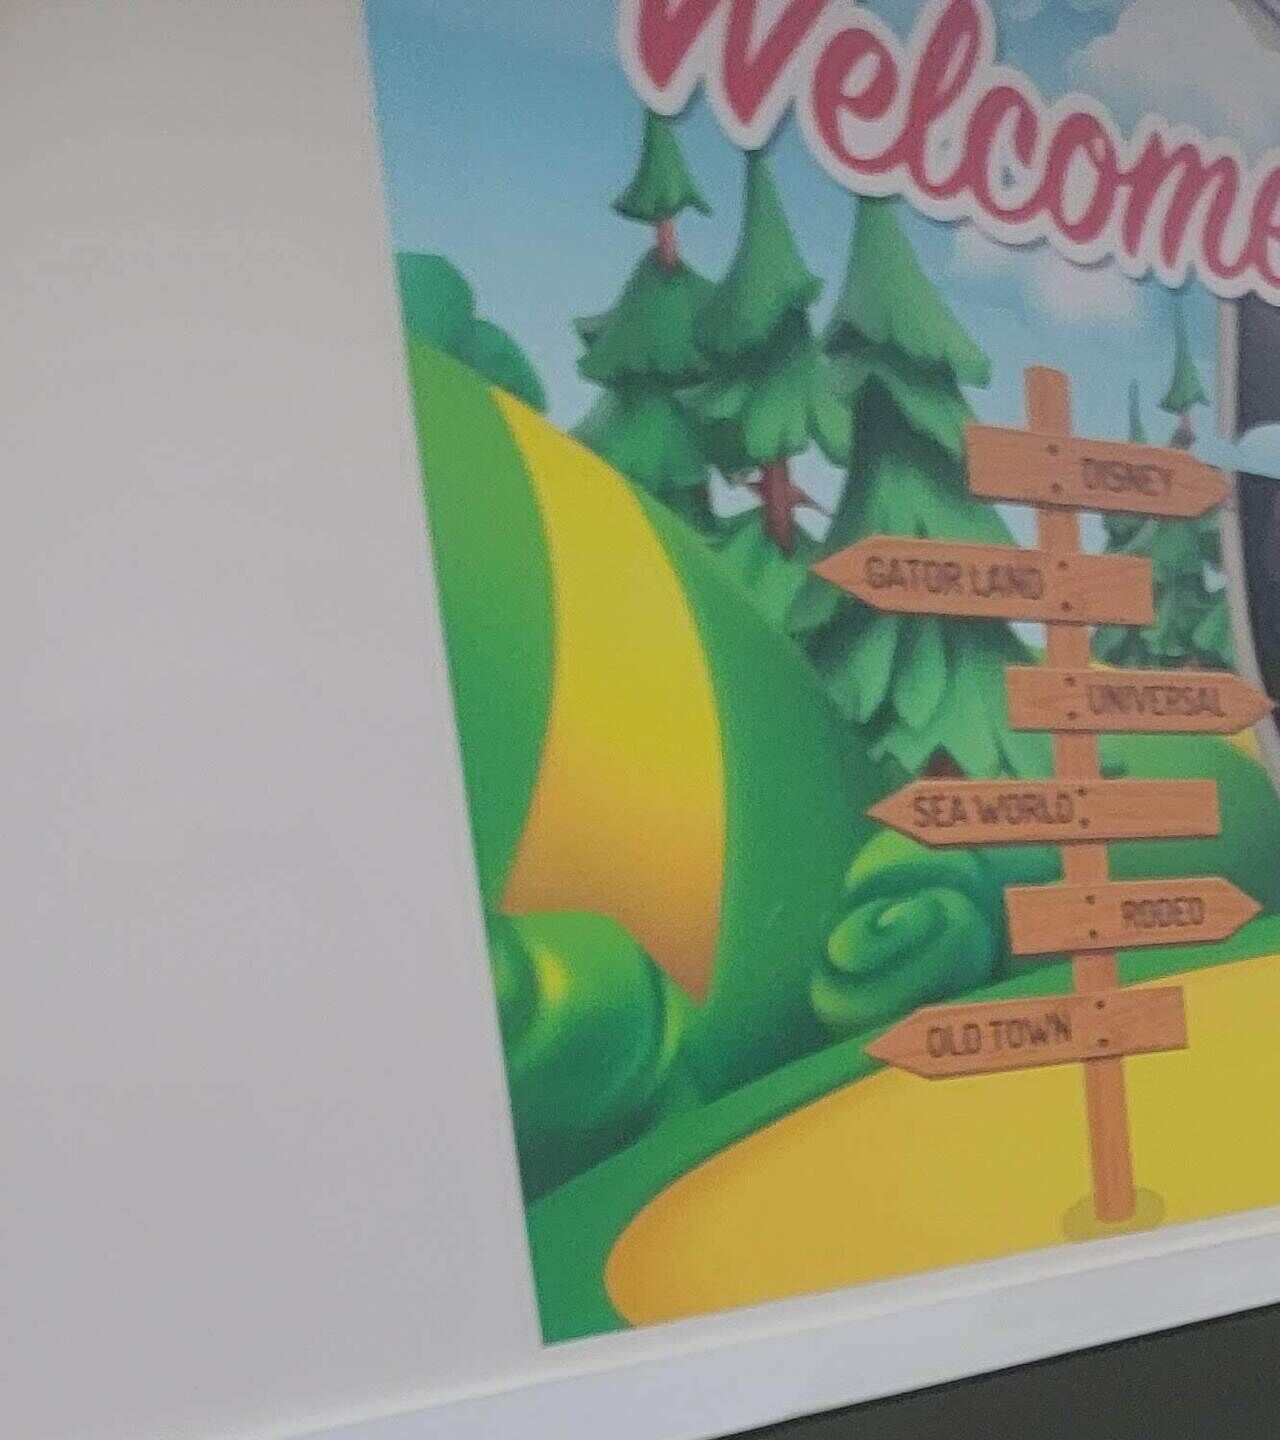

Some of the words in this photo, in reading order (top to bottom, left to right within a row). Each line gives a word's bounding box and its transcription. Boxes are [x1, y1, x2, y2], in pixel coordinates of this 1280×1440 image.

[1081, 457, 1174, 497] DISNEY
[864, 556, 962, 595] GATOR
[970, 567, 1044, 600] LAND
[1086, 684, 1225, 717] UNIVERSAL
[913, 795, 967, 829] SEA
[977, 793, 1074, 826] WORLD
[1120, 897, 1204, 928] RODEO
[926, 1024, 982, 1057] OLD
[990, 1013, 1072, 1047] TOWN
